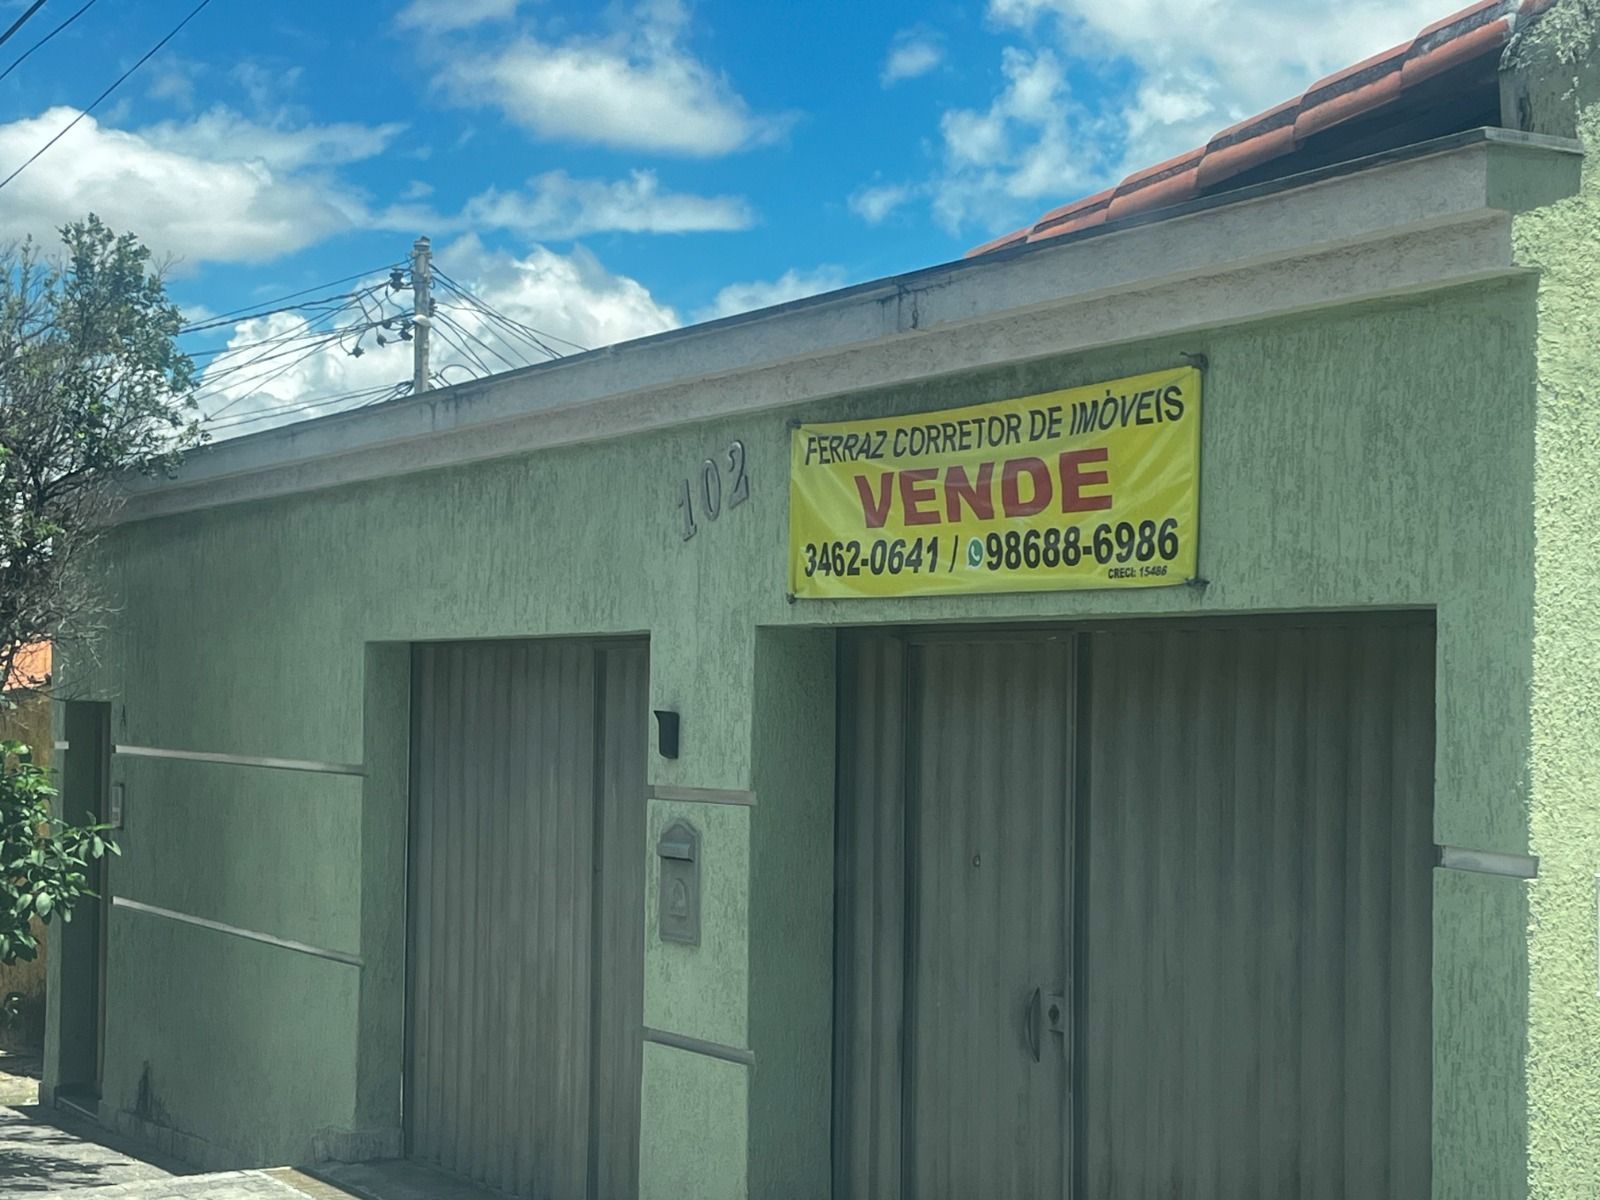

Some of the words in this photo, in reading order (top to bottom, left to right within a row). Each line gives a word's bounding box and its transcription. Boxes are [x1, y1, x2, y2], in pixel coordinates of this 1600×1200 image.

[805, 431, 884, 465] FERRAZ
[893, 413, 1020, 457] CORRETOR
[1029, 406, 1062, 439] DE
[1069, 386, 1184, 436] IMÓVEIS
[679, 440, 749, 542] 102
[854, 447, 1113, 529] VENDE
[804, 535, 939, 577] 3462-0641
[948, 535, 959, 573] /
[986, 518, 1179, 570] 98688-6986
[1108, 566, 1136, 579] CRECI:
